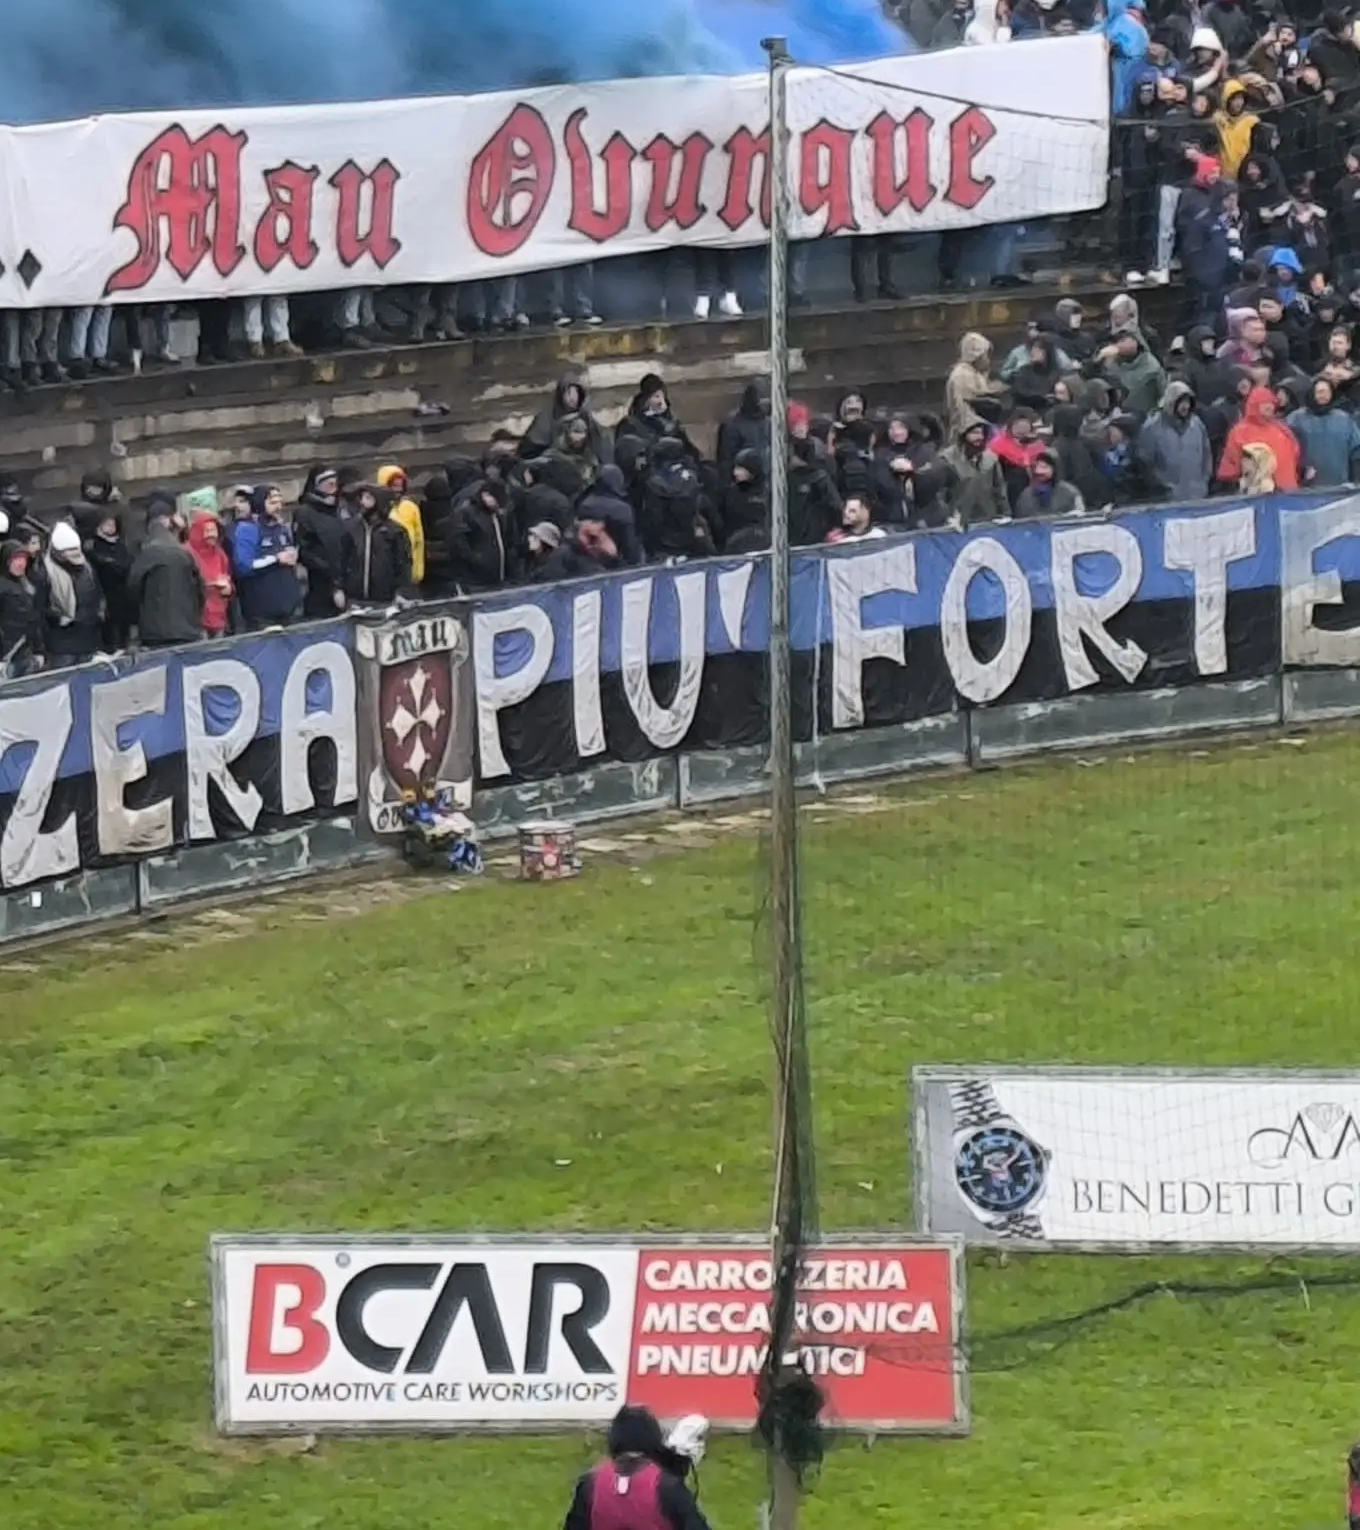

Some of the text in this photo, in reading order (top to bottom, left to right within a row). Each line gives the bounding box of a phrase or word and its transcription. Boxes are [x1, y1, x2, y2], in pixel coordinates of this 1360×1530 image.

[103, 122, 402, 298] Mau
[465, 100, 999, 258] Ovunque
[473, 561, 754, 779] PIU'
[827, 493, 1360, 729] FORTE
[1073, 1179, 1360, 1217] BENEDETTI G
[644, 1259, 908, 1292] CARROZERIA
[245, 1262, 616, 1374] BCAR
[640, 1301, 939, 1334] MECCARONICA
[637, 1344, 866, 1376] PNEUMTICI
[245, 1382, 619, 1402] AUTOMOTIVE CARE WORKSHOPS
